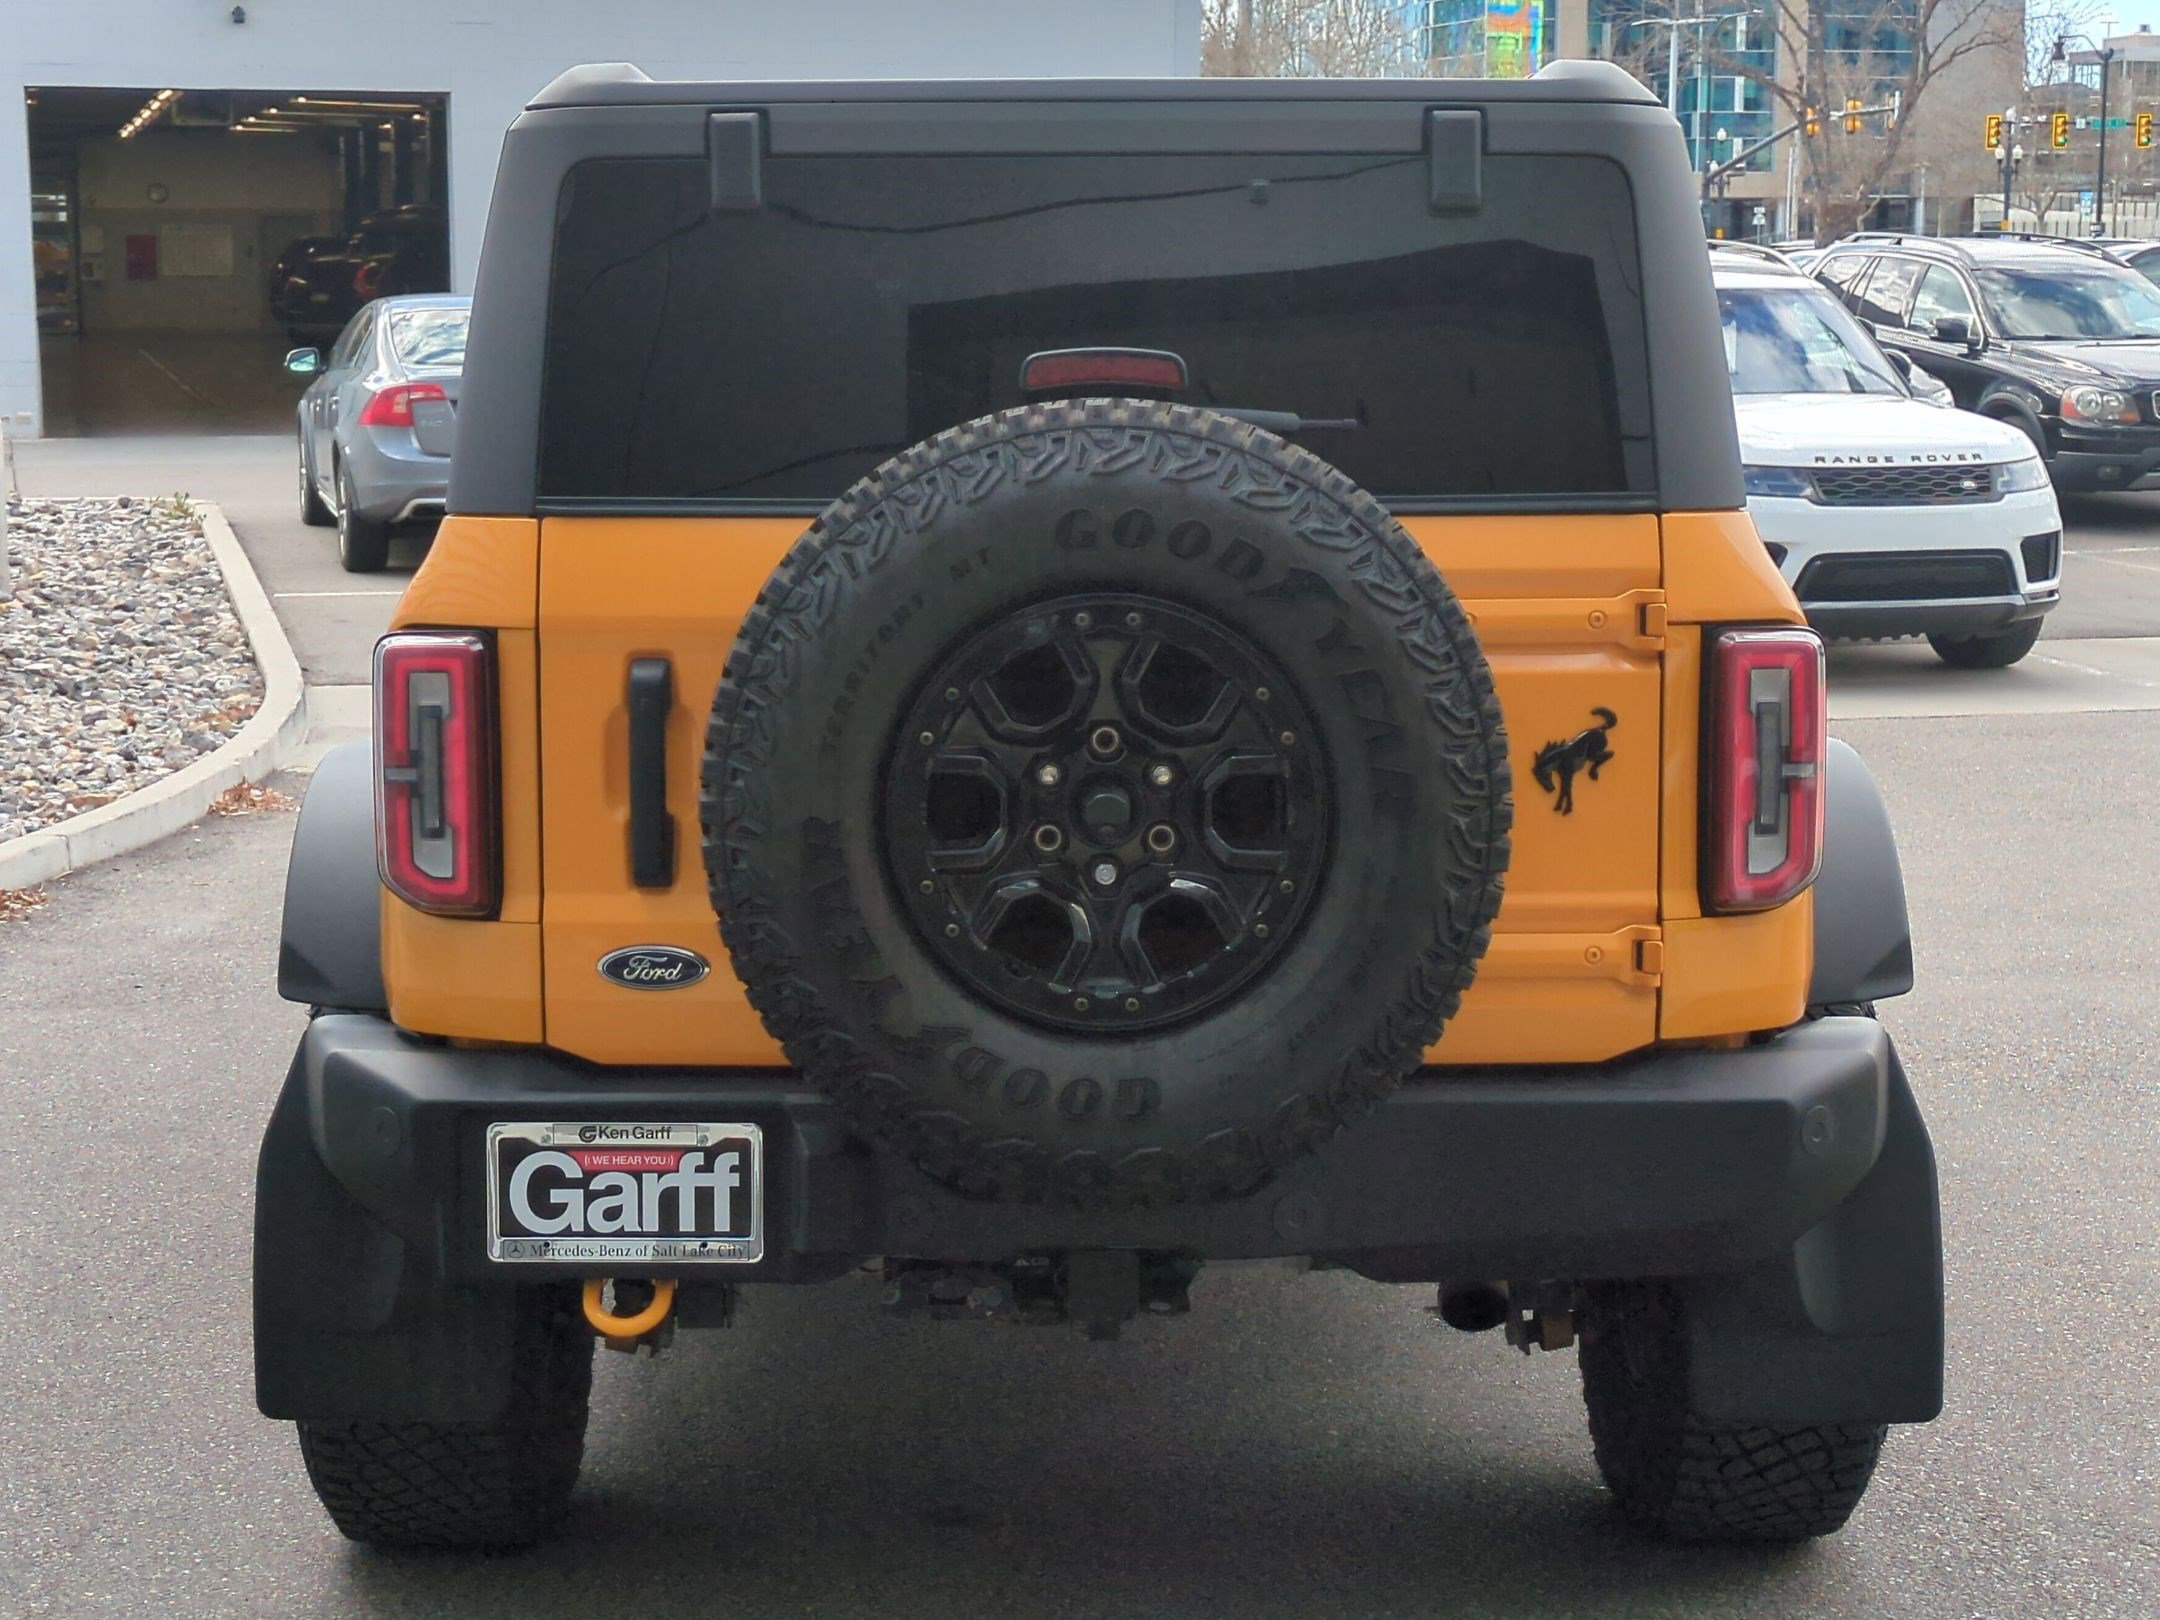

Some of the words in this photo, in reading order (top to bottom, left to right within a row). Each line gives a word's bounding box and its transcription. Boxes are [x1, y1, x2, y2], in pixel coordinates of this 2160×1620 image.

[1814, 455, 1895, 464] RANGE
[1910, 453, 1983, 463] ROVER
[622, 955, 683, 981] Ford
[599, 1126, 629, 1139] Ken
[632, 1126, 672, 1139] Garff
[592, 1155, 609, 1165] WE
[612, 1155, 641, 1165] HEAR
[643, 1155, 666, 1165] YOU
[509, 1150, 740, 1234] Garff
[530, 1243, 631, 1257] Mercedes-Benz
[635, 1242, 649, 1257] of
[652, 1242, 678, 1257] Salt
[682, 1242, 714, 1257] Lake
[718, 1242, 746, 1259] City
